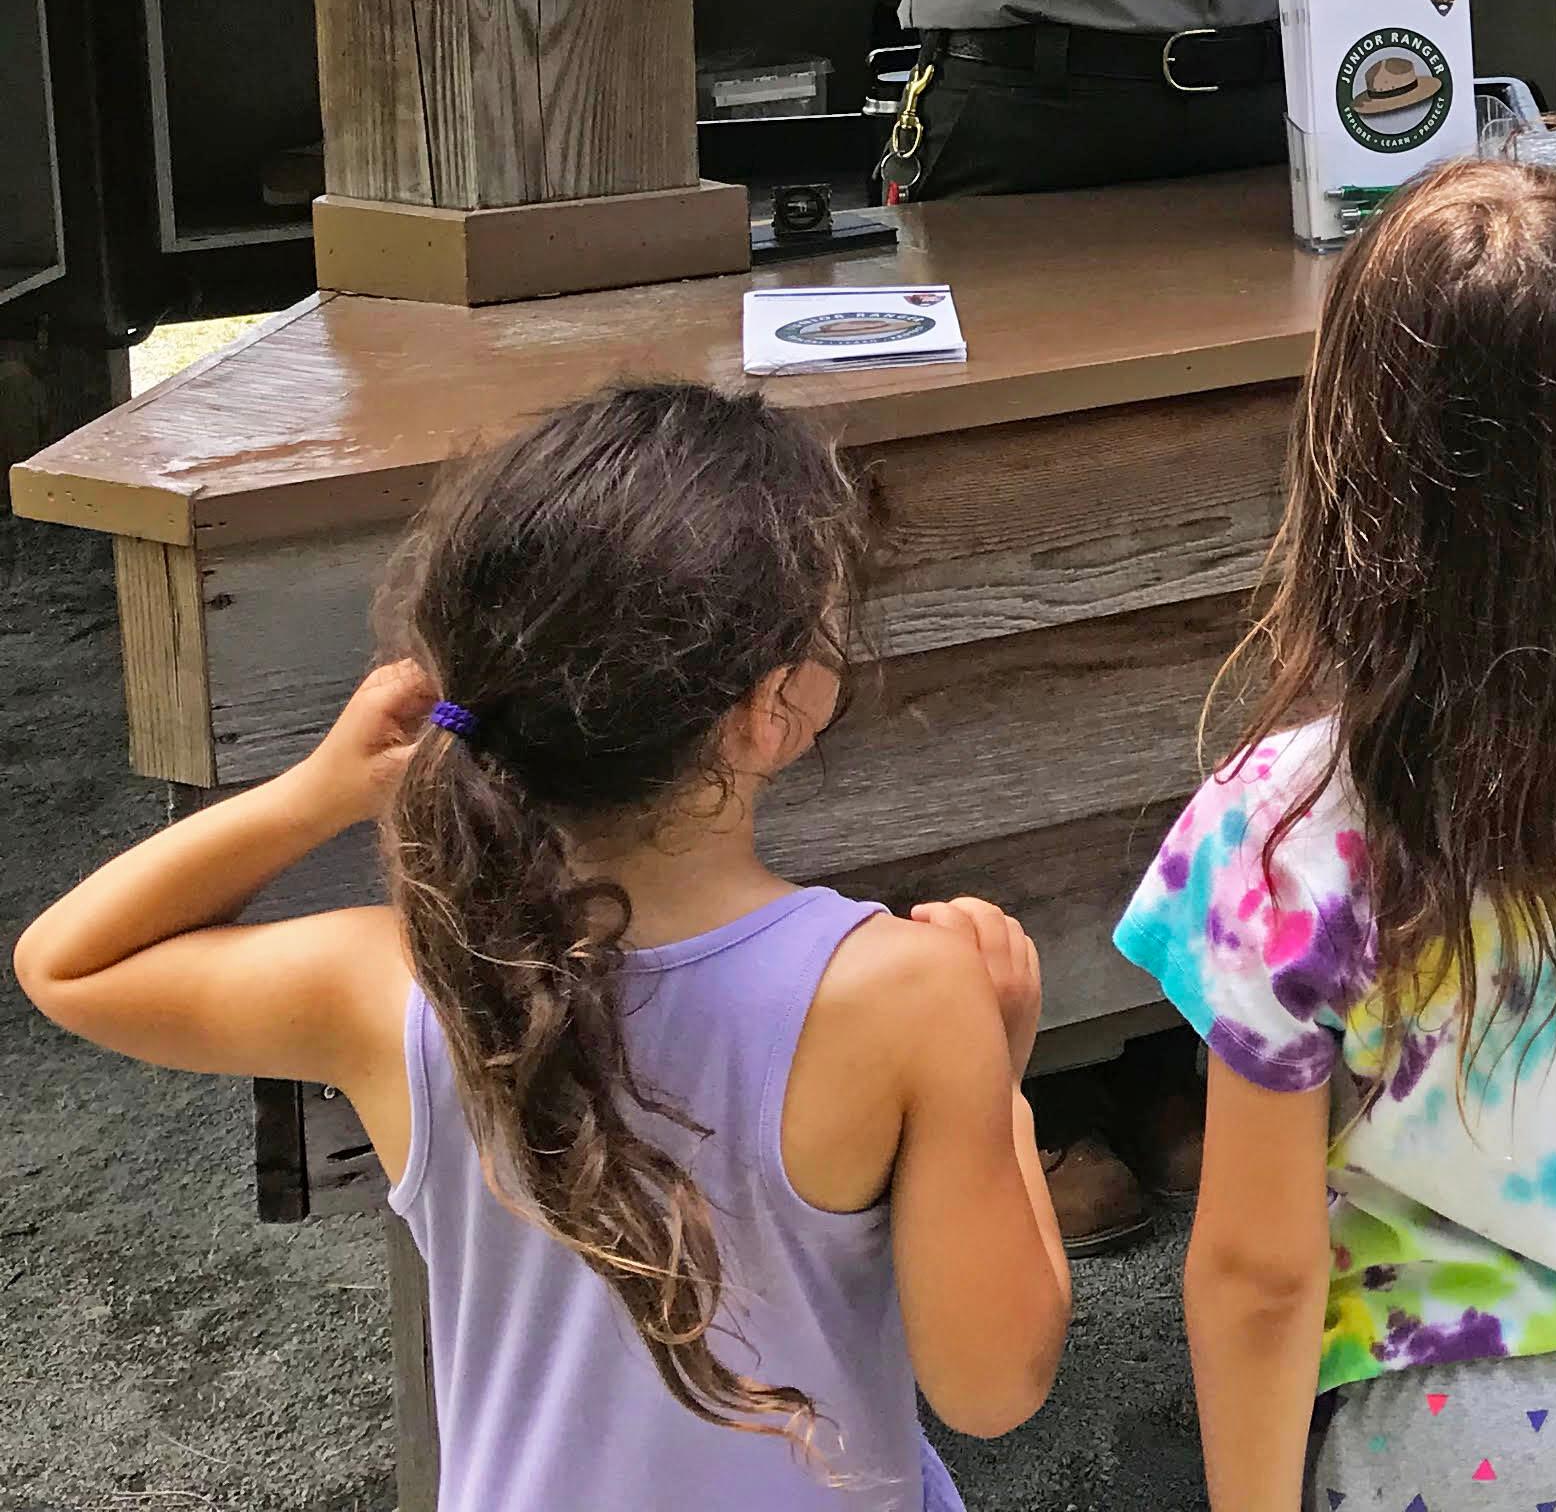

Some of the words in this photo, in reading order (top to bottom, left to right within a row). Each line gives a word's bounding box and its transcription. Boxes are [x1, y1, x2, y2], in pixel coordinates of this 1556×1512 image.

[1341, 34, 1384, 84] JUNIOR
[1391, 32, 1445, 75] RANGER
[1344, 106, 1372, 142] EXPLORE
[1380, 136, 1411, 147] LEARN
[1418, 97, 1445, 136] PROTECT
